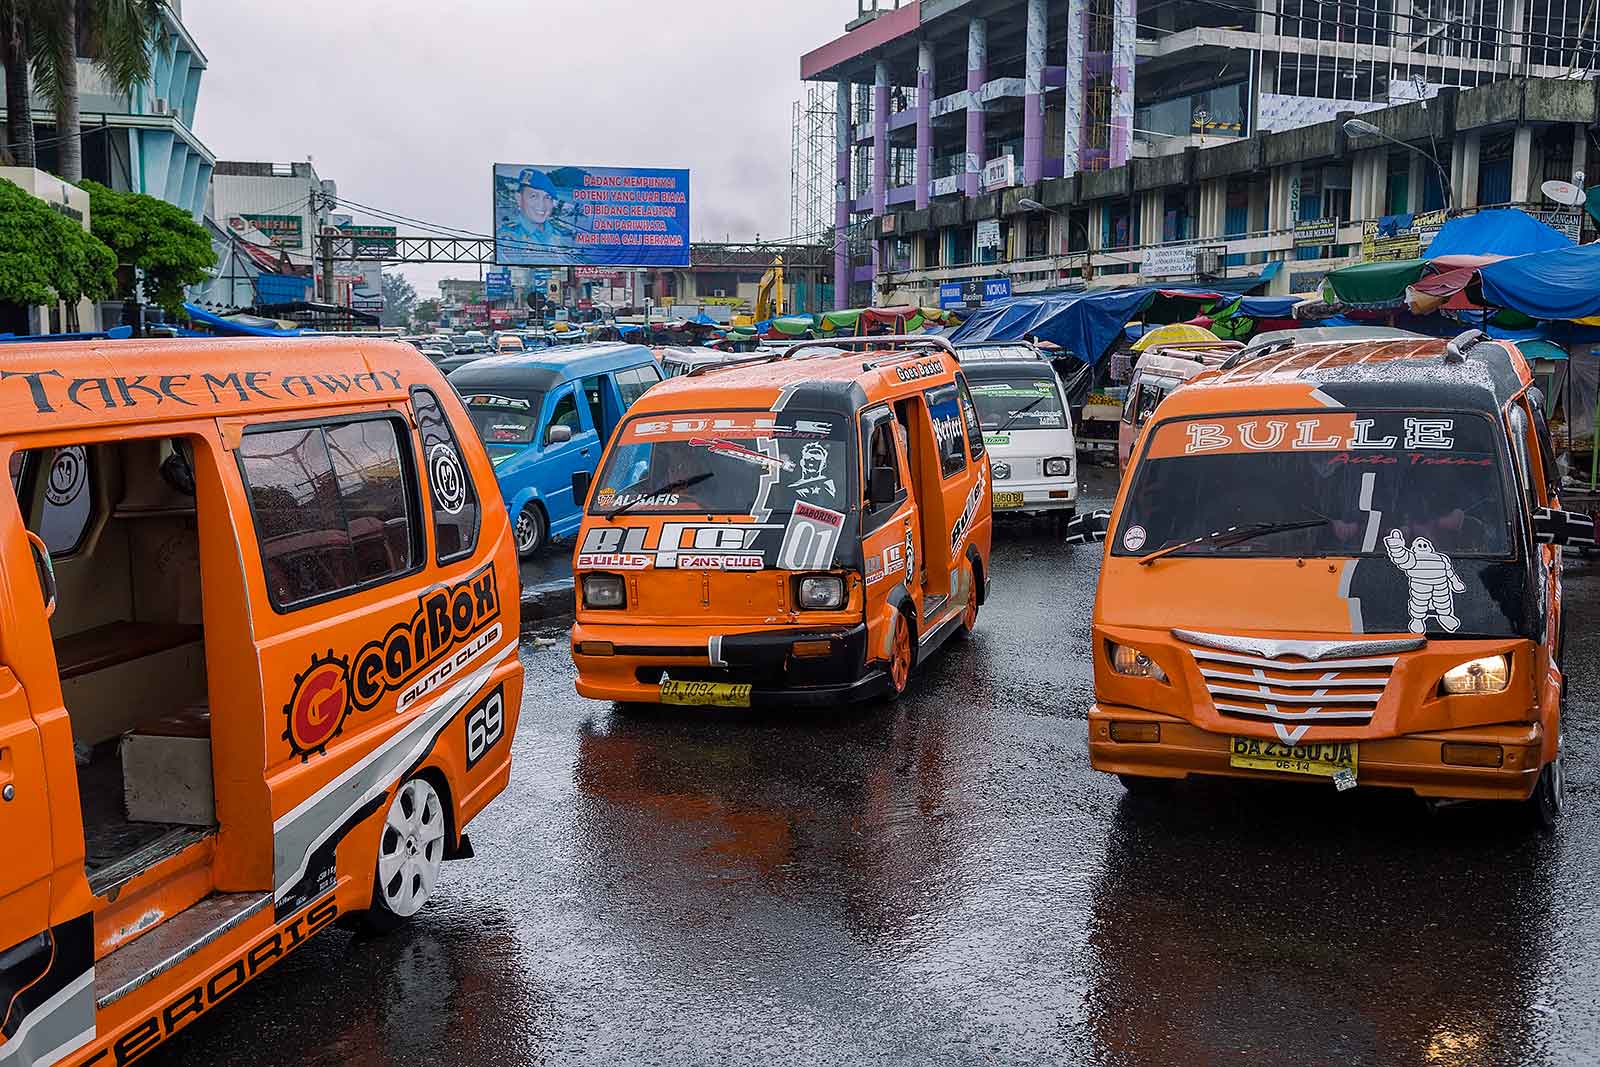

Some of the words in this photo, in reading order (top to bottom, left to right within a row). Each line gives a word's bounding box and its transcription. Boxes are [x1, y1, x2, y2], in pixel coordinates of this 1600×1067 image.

[583, 175, 622, 186] PADANG
[623, 176, 676, 188] MEMPUNYAI
[573, 189, 610, 201] POTENSI
[610, 191, 635, 202] YANG
[637, 191, 660, 202] LUAR
[1290, 177, 1300, 223] ASRI
[583, 205, 593, 216] DI
[594, 205, 630, 216] BIDANG
[631, 206, 676, 217] KELAUTAN
[593, 219, 614, 230] DAN
[576, 233, 599, 244] MARI
[600, 233, 621, 244] KITA
[621, 233, 642, 245] GALI
[986, 283, 1008, 296] NOKIA
[0, 370, 199, 414] TAKE
[200, 370, 282, 404] ME
[280, 369, 402, 402] AWAY
[1184, 416, 1456, 455] BULLE
[1327, 452, 1398, 465] Auto
[784, 520, 833, 571] 01
[578, 555, 647, 567] BULLE
[681, 557, 720, 567] FANS
[725, 557, 762, 567] CLUB
[401, 666, 452, 706] AUTO
[455, 626, 498, 667] CLUB
[467, 692, 503, 763] 69
[80, 895, 339, 1067] ERORIS
